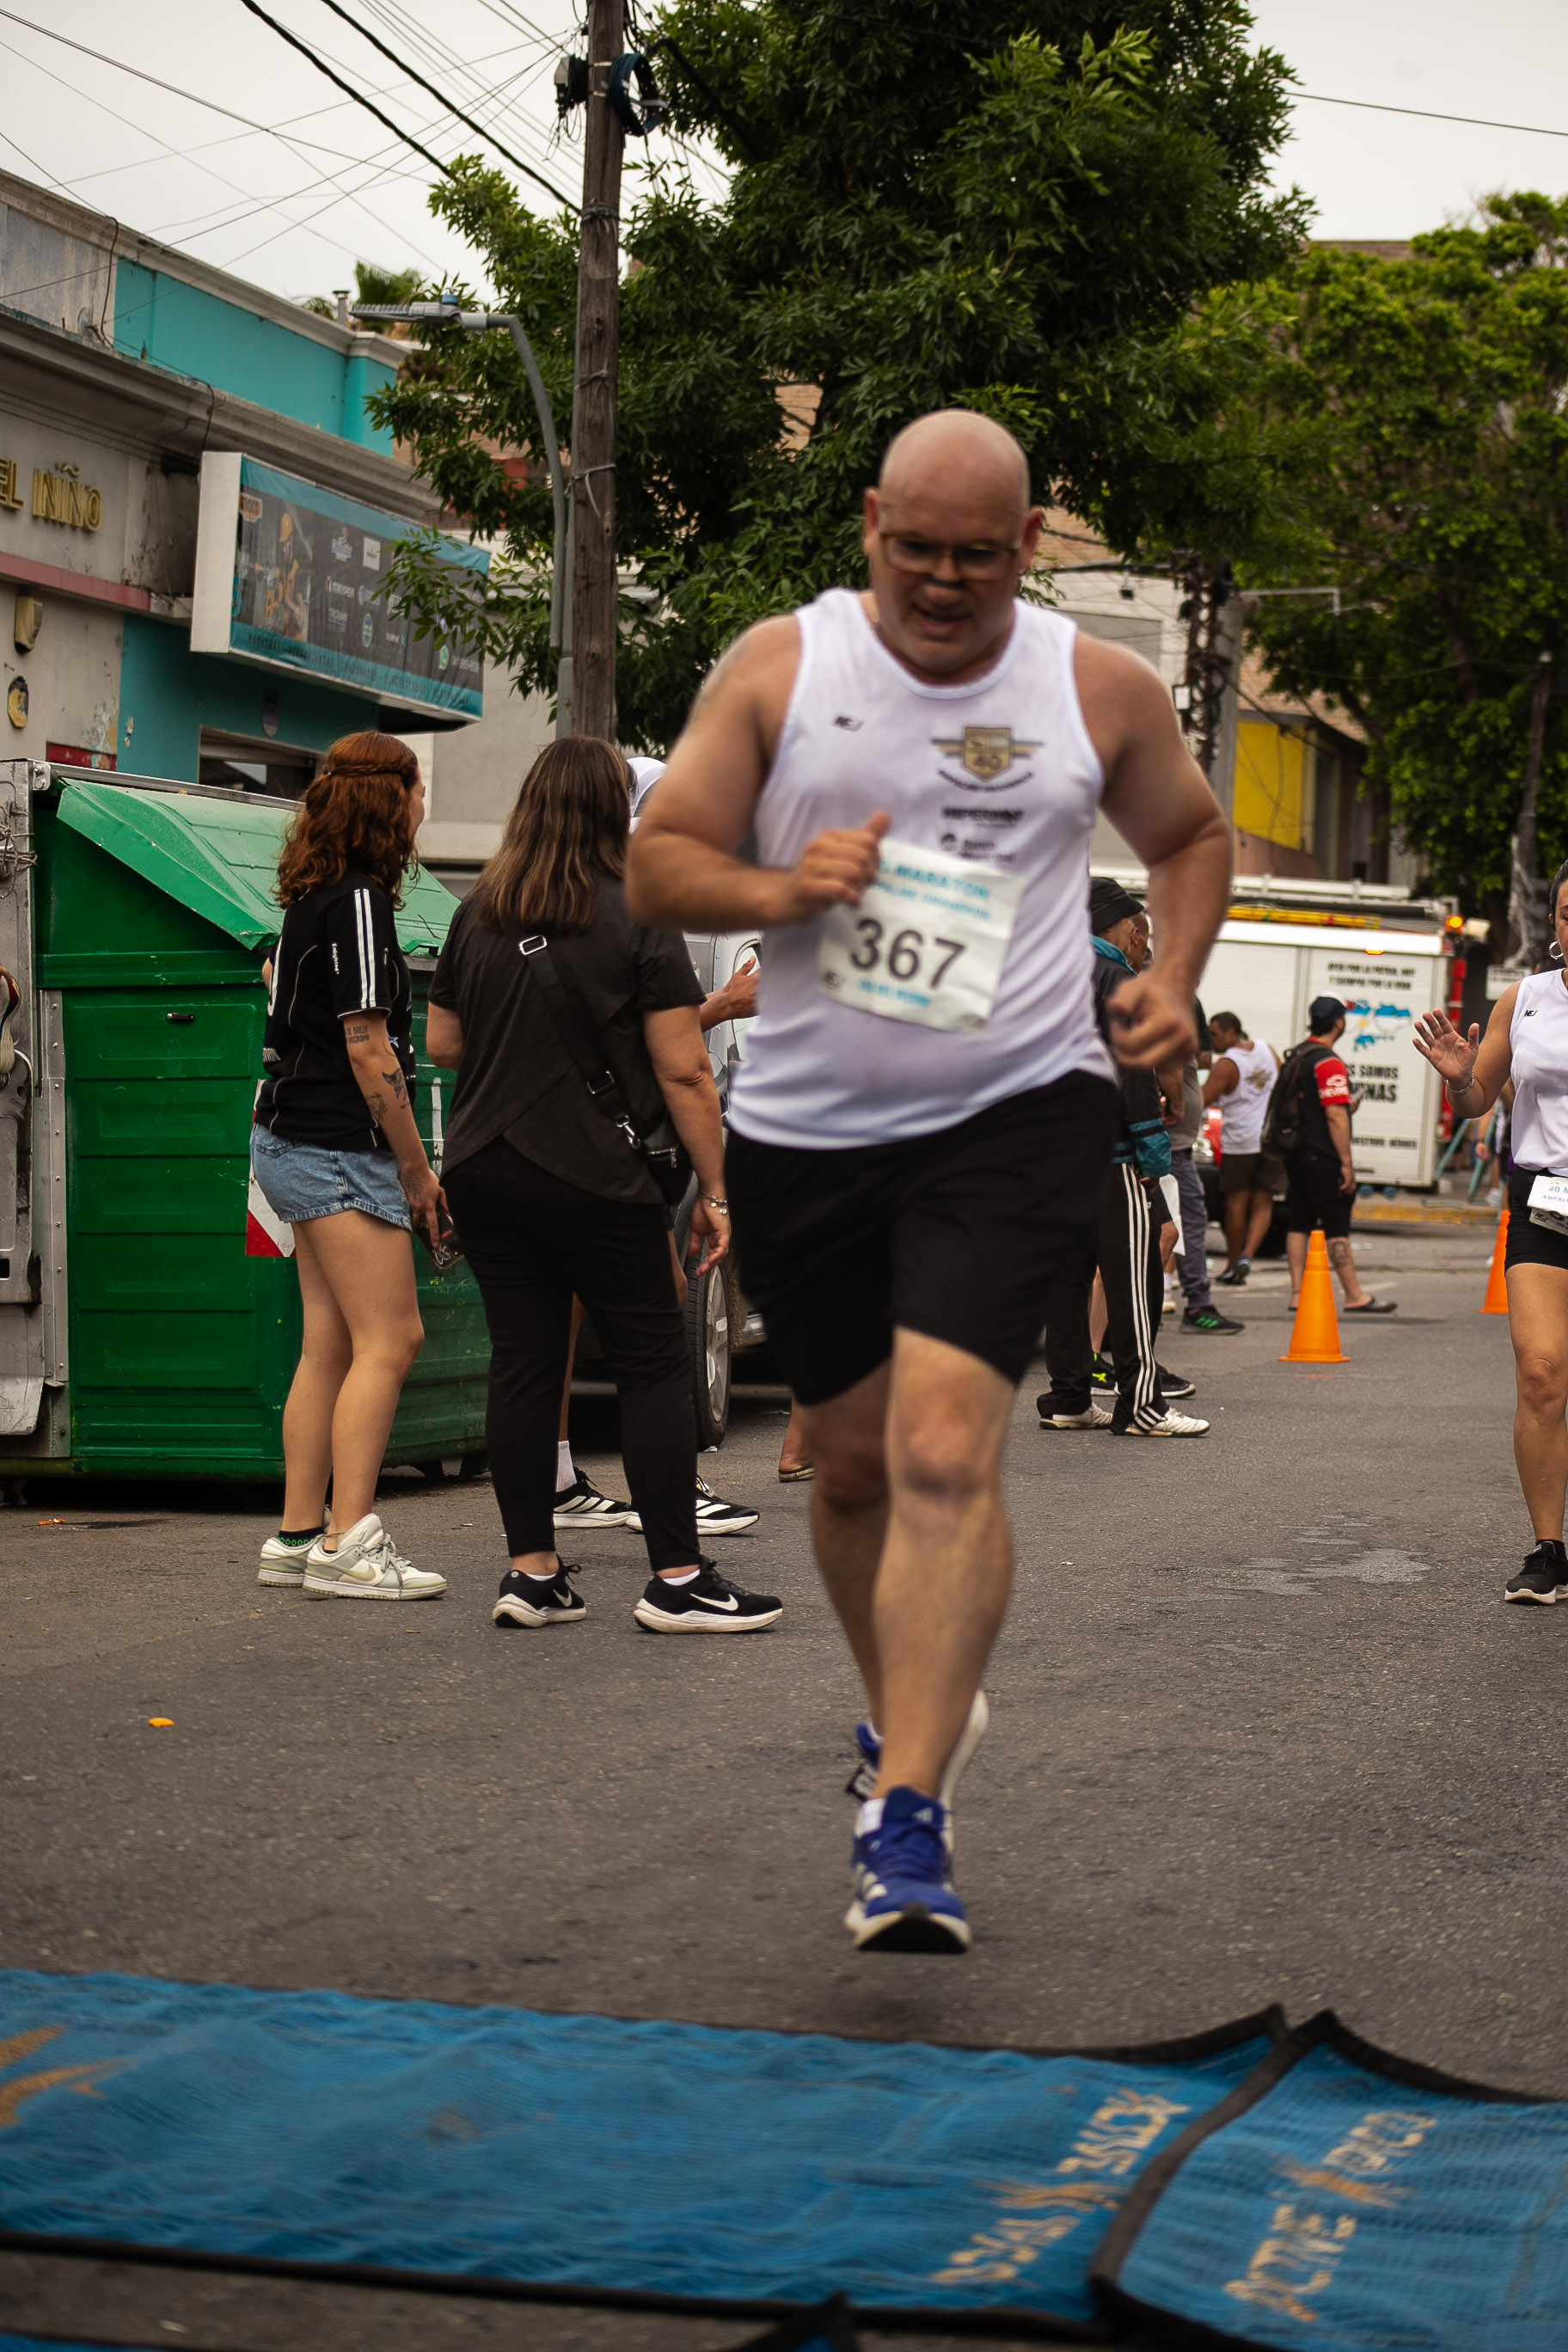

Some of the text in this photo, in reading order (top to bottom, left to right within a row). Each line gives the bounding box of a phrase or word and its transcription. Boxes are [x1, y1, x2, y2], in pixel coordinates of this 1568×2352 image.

[33, 462, 102, 531] NIÑO
[850, 917, 965, 989] 367
[1360, 1065, 1399, 1079] SOMOS
